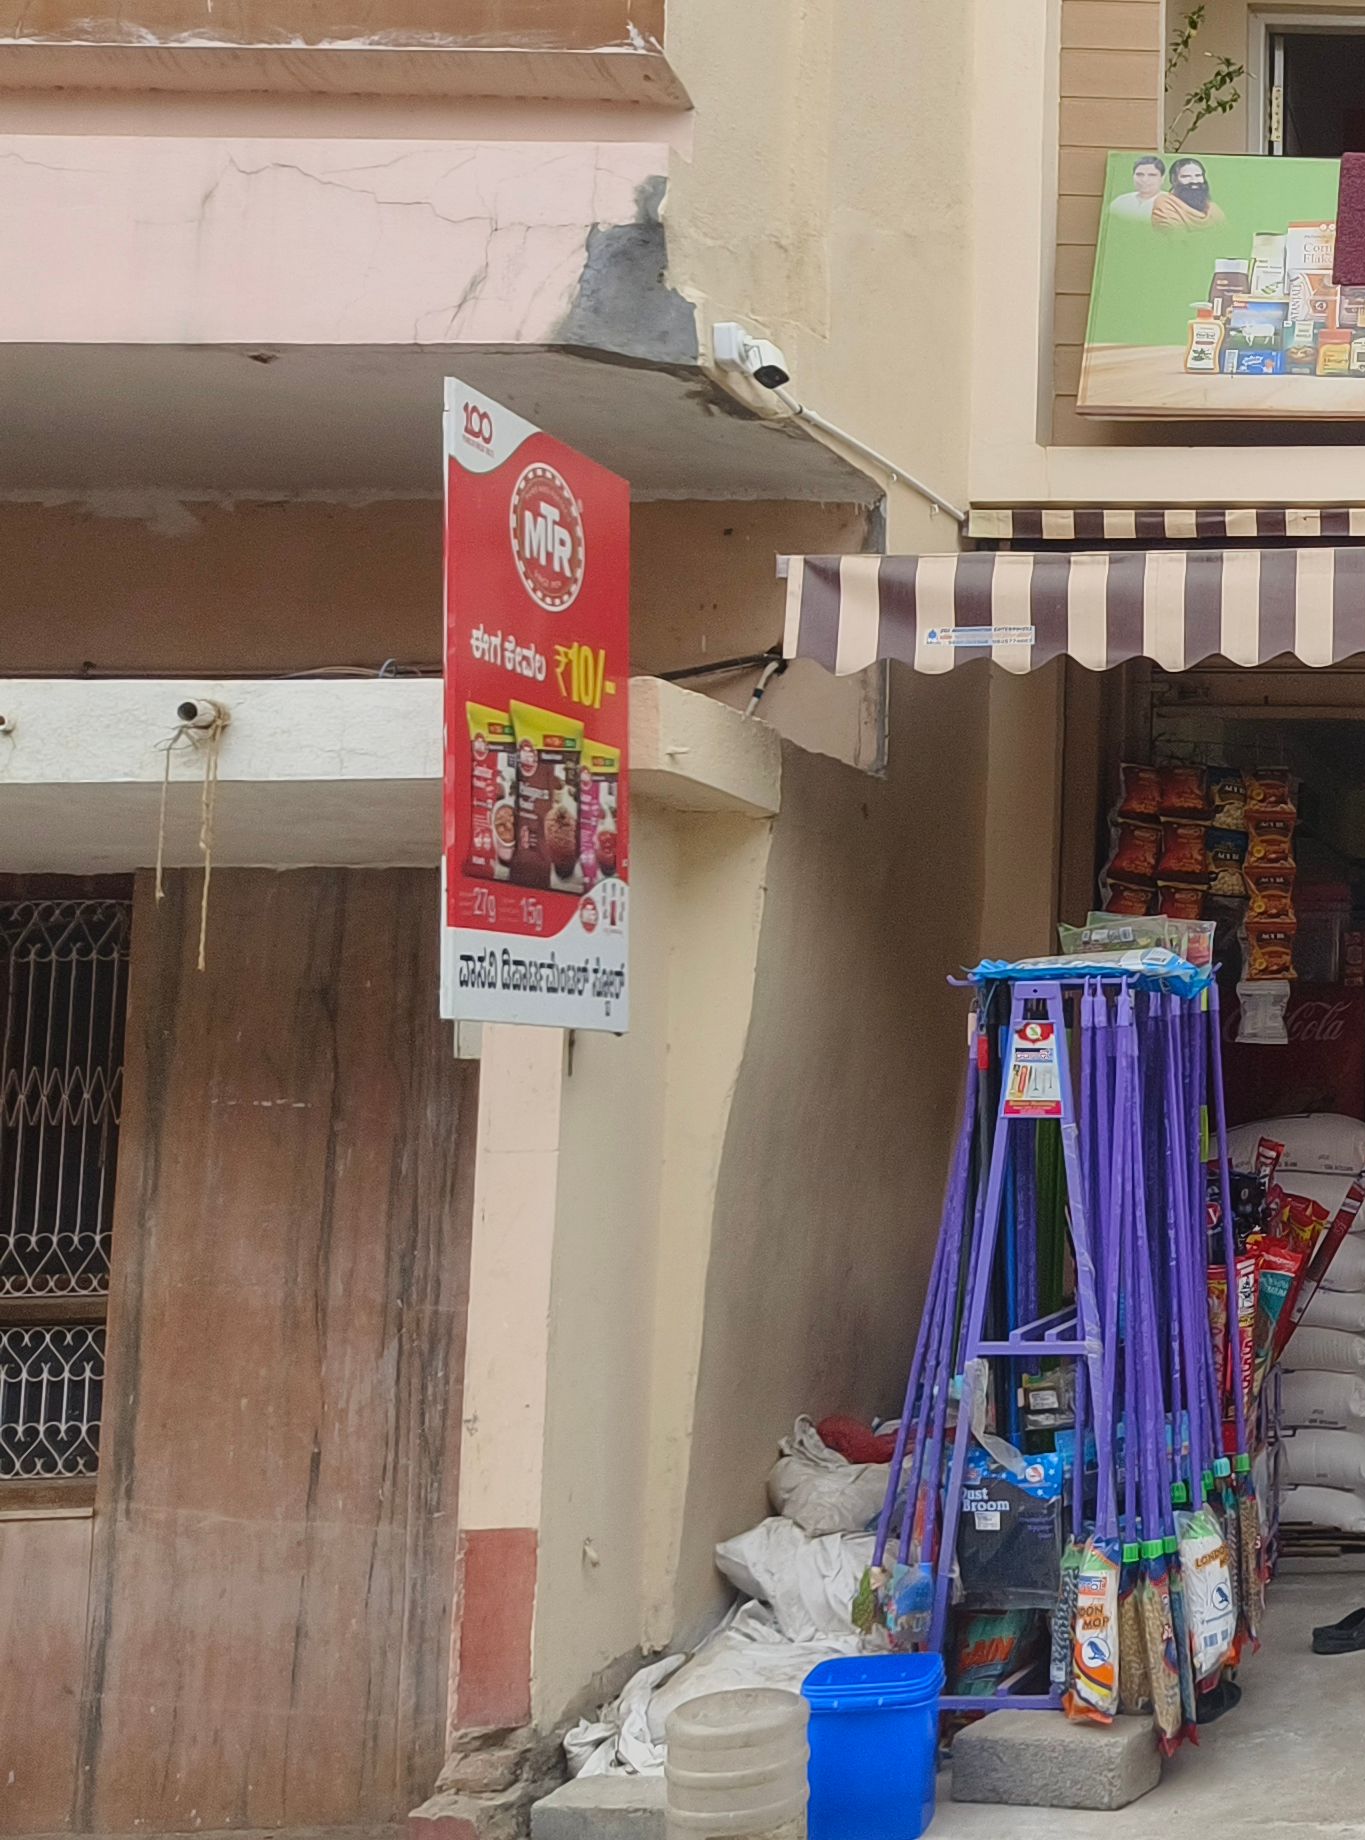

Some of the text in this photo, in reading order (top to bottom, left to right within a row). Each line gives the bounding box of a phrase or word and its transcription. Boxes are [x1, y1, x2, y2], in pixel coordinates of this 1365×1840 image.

[462, 401, 494, 445] 100
[524, 501, 573, 578] MTR
[470, 623, 502, 666] ಈಗ
[504, 635, 547, 682] ಕೇವಲ
[472, 887, 496, 924] 27g
[520, 896, 544, 931] 15g
[459, 946, 498, 990] ವಾಸವಿ
[962, 1500, 1010, 1512] Broom
[963, 1487, 989, 1501] ust
